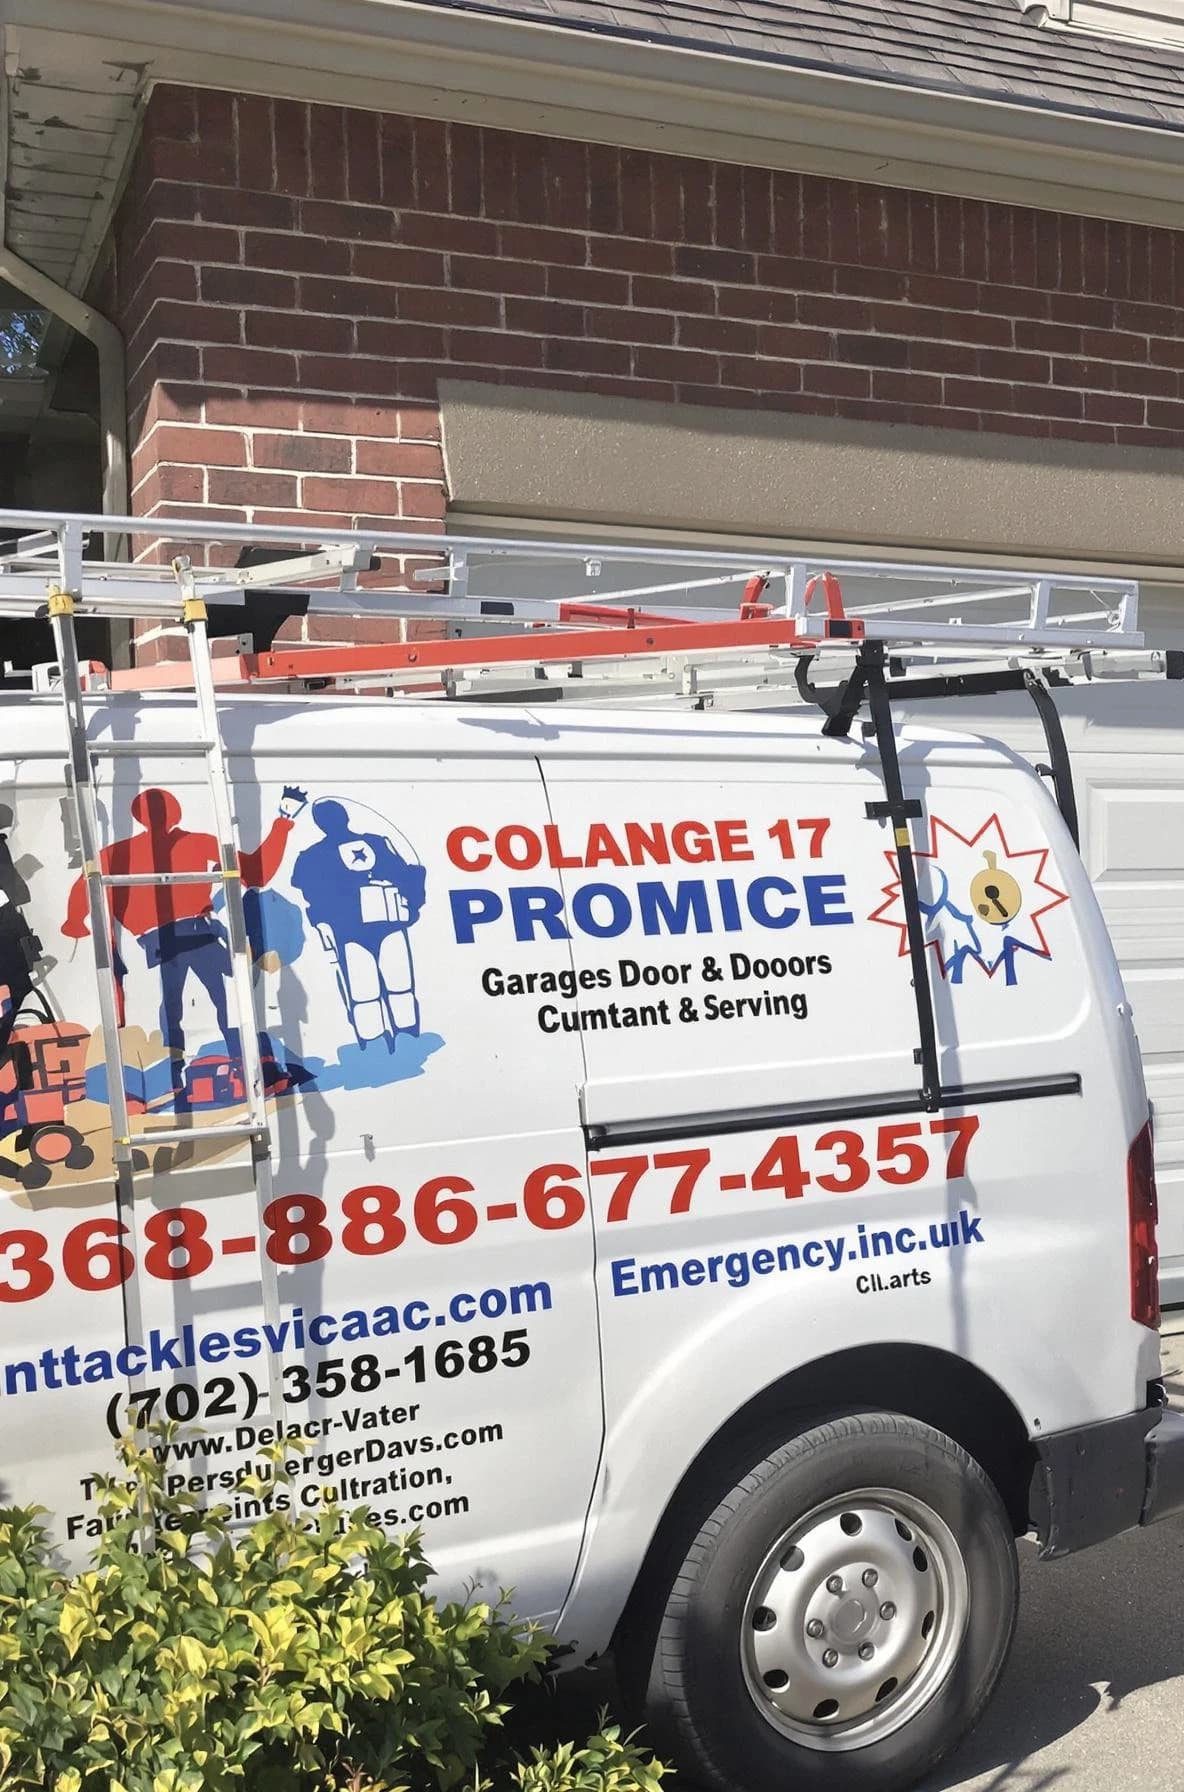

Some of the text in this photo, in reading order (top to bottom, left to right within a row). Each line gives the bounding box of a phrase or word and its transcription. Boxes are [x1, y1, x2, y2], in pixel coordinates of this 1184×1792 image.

[446, 818, 831, 872] COLANGE 17
[448, 874, 854, 944] PROMICE
[482, 952, 832, 998] Garages Door & Dooors
[679, 997, 699, 1023] &
[704, 990, 808, 1020] Serving
